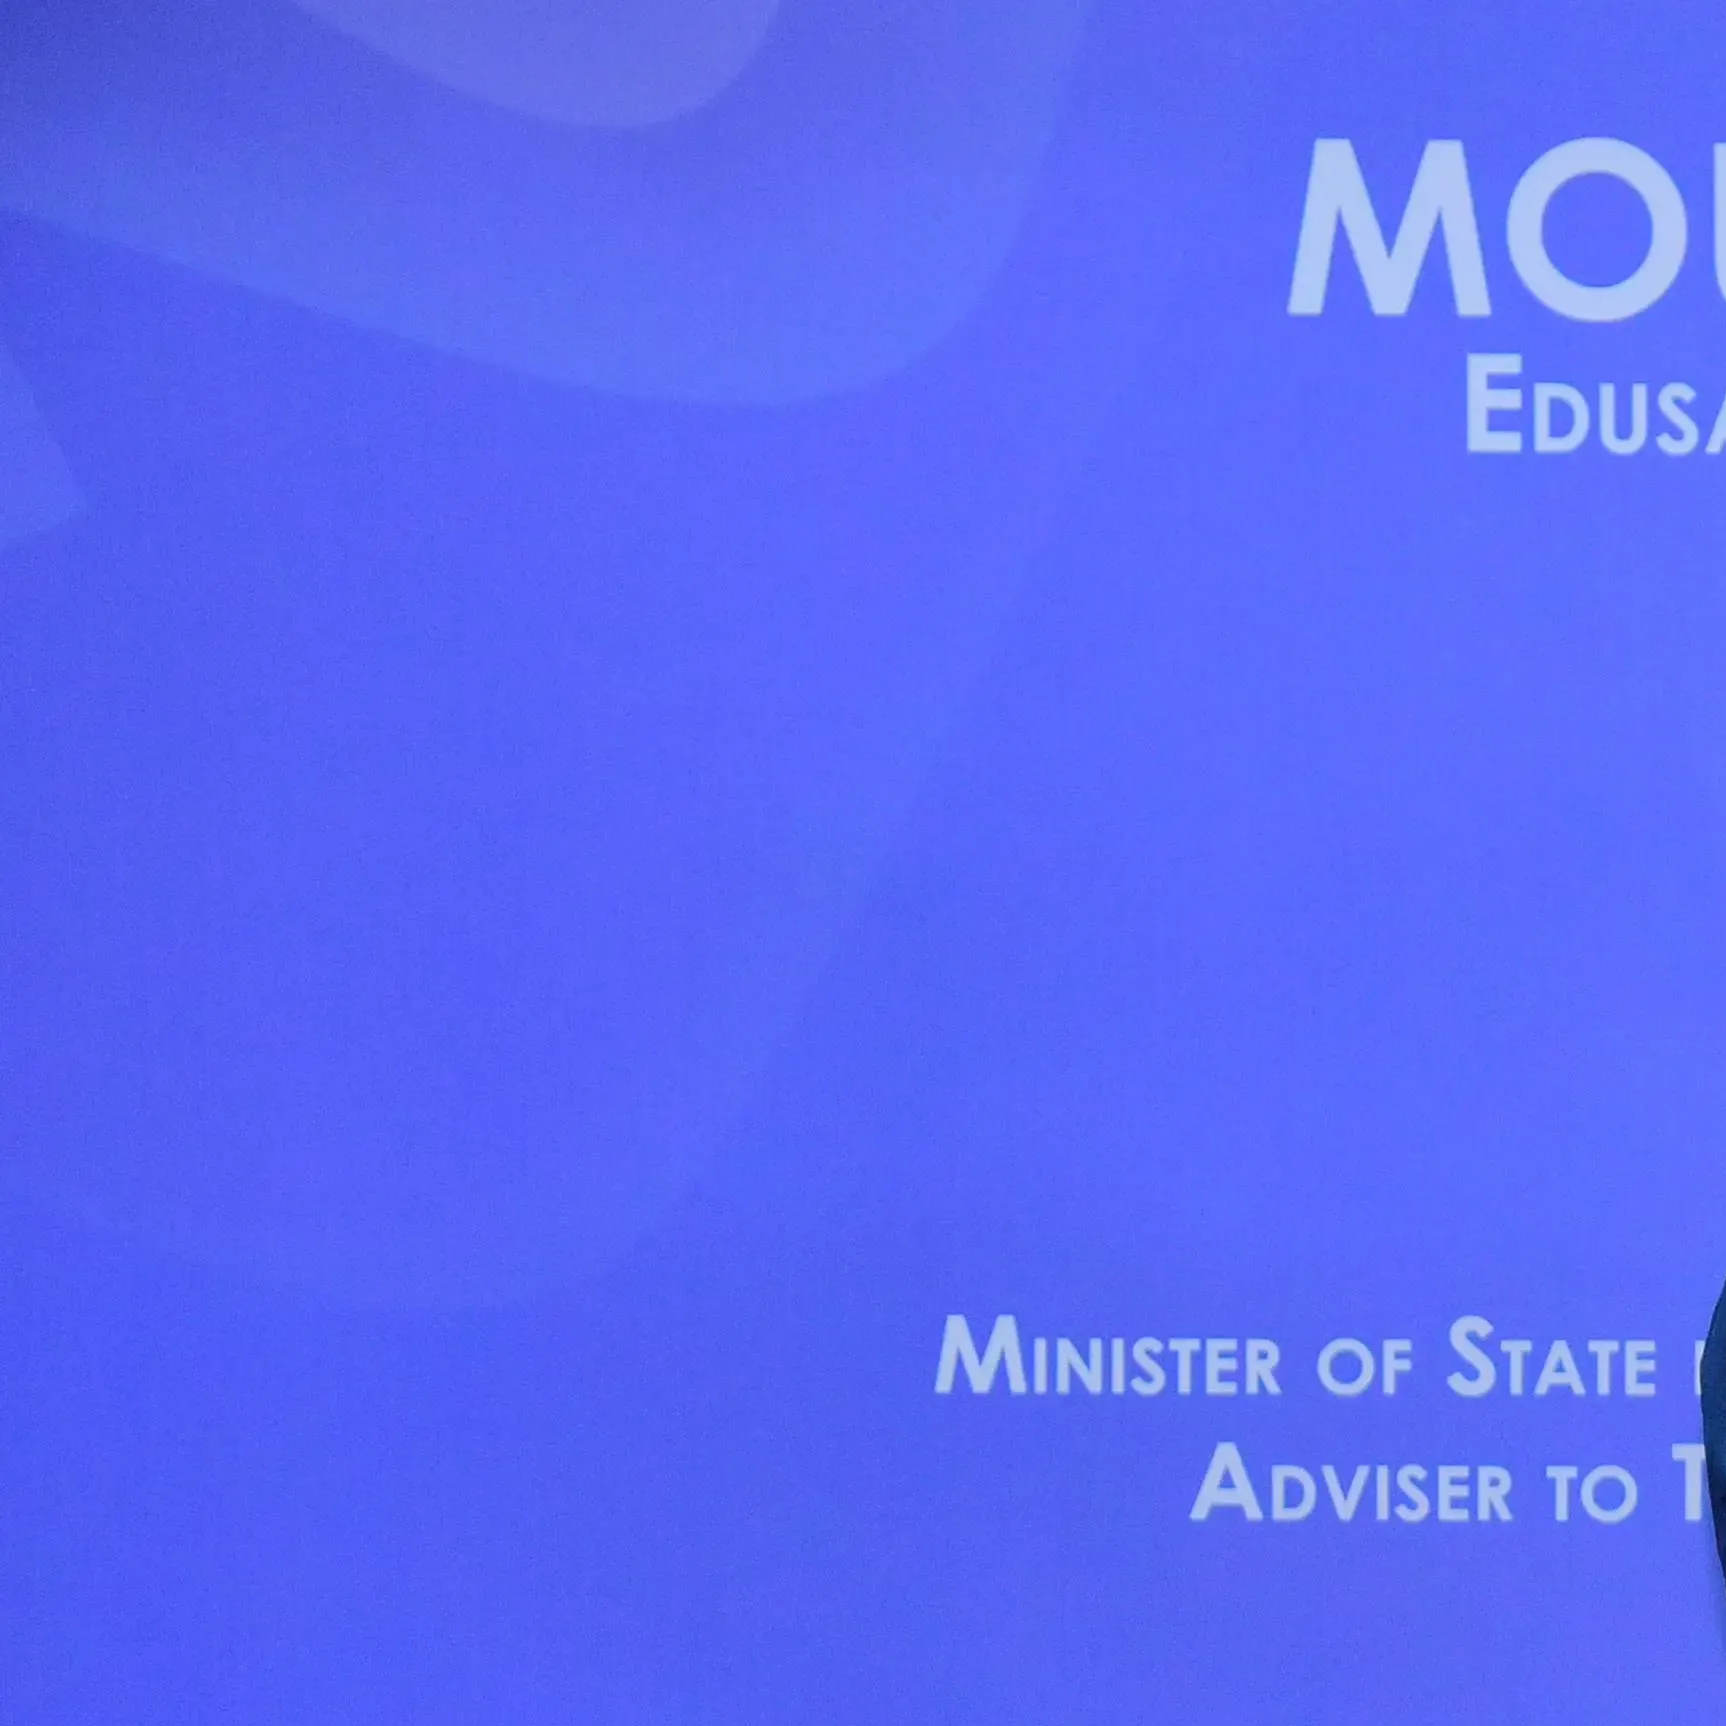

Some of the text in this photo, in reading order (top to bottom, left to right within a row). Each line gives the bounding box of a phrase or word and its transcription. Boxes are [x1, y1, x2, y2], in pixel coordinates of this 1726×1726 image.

[934, 1314, 1281, 1396] MINISTER
[1317, 1338, 1412, 1397] OF
[1447, 1315, 1656, 1397] STATE
[1189, 1442, 1513, 1522] ADVISER
[1546, 1465, 1638, 1523] TO
